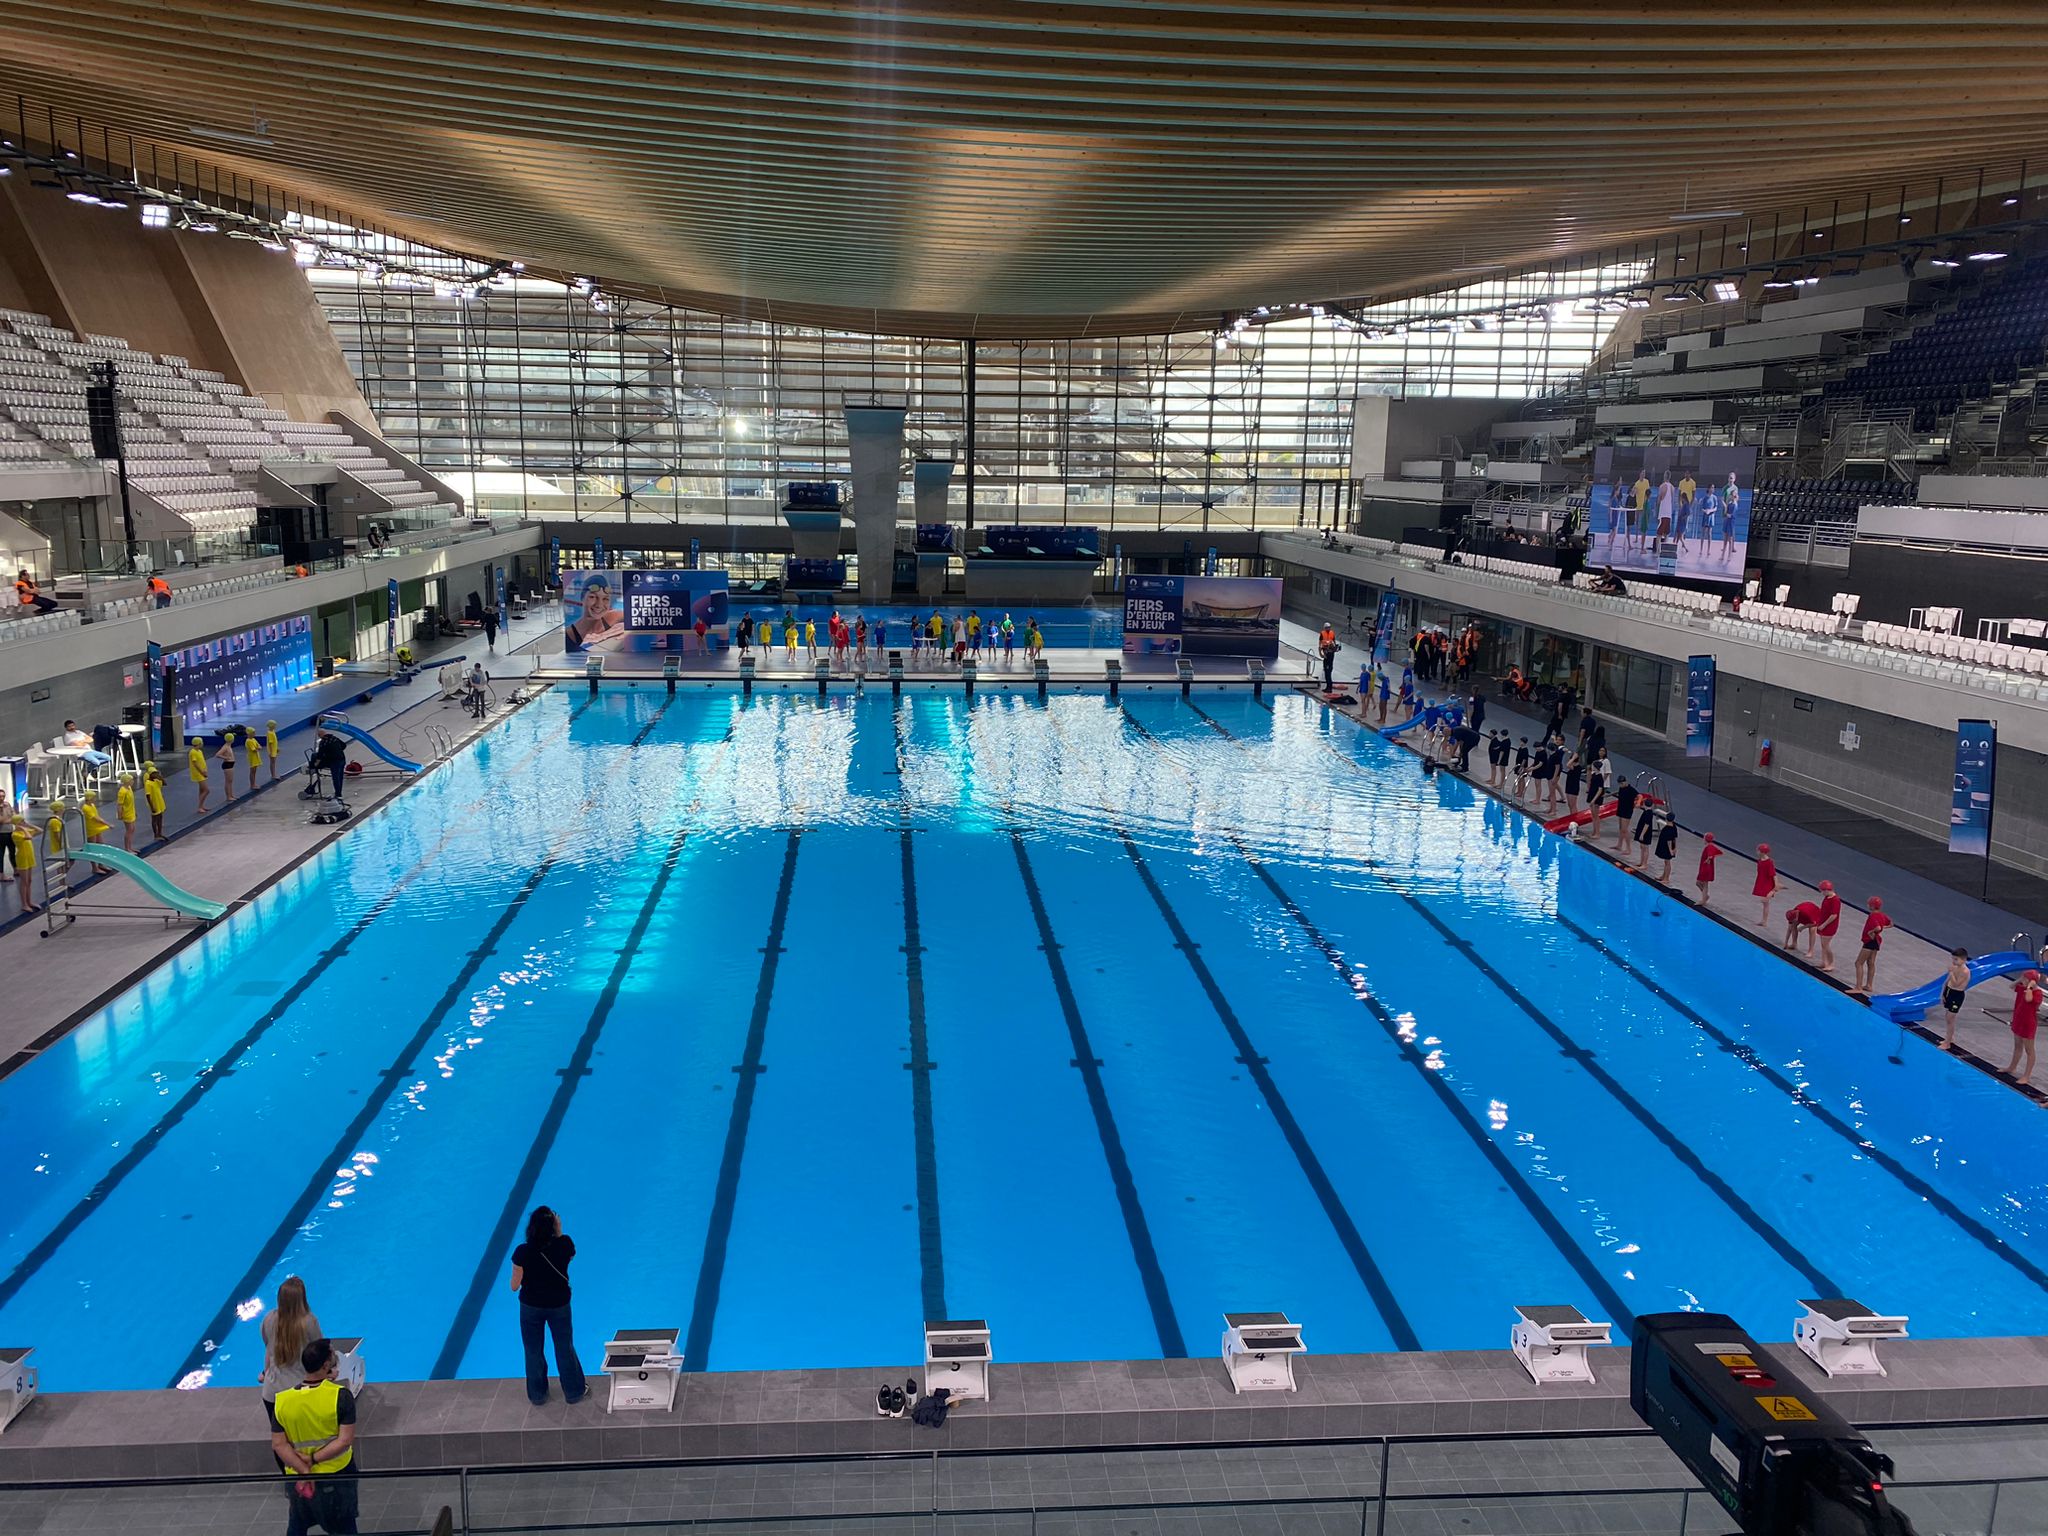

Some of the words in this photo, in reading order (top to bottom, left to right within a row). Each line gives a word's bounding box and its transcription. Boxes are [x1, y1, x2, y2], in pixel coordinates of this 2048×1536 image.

[631, 595, 670, 607] FIERS
[1127, 598, 1164, 611] FIERS
[631, 607, 683, 617] D'ENTRER
[1126, 611, 1175, 621] D'ENTRER
[631, 617, 646, 626] EN
[647, 617, 674, 626] JEUX
[1126, 619, 1139, 629] EN
[1141, 620, 1165, 630] JEUX
[1808, 1327, 1817, 1342] 2
[1521, 1334, 1528, 1348] 3
[1552, 1344, 1562, 1355] 3
[1254, 1352, 1266, 1361] 4
[950, 1361, 961, 1372] 5
[16, 1376, 23, 1393] 8
